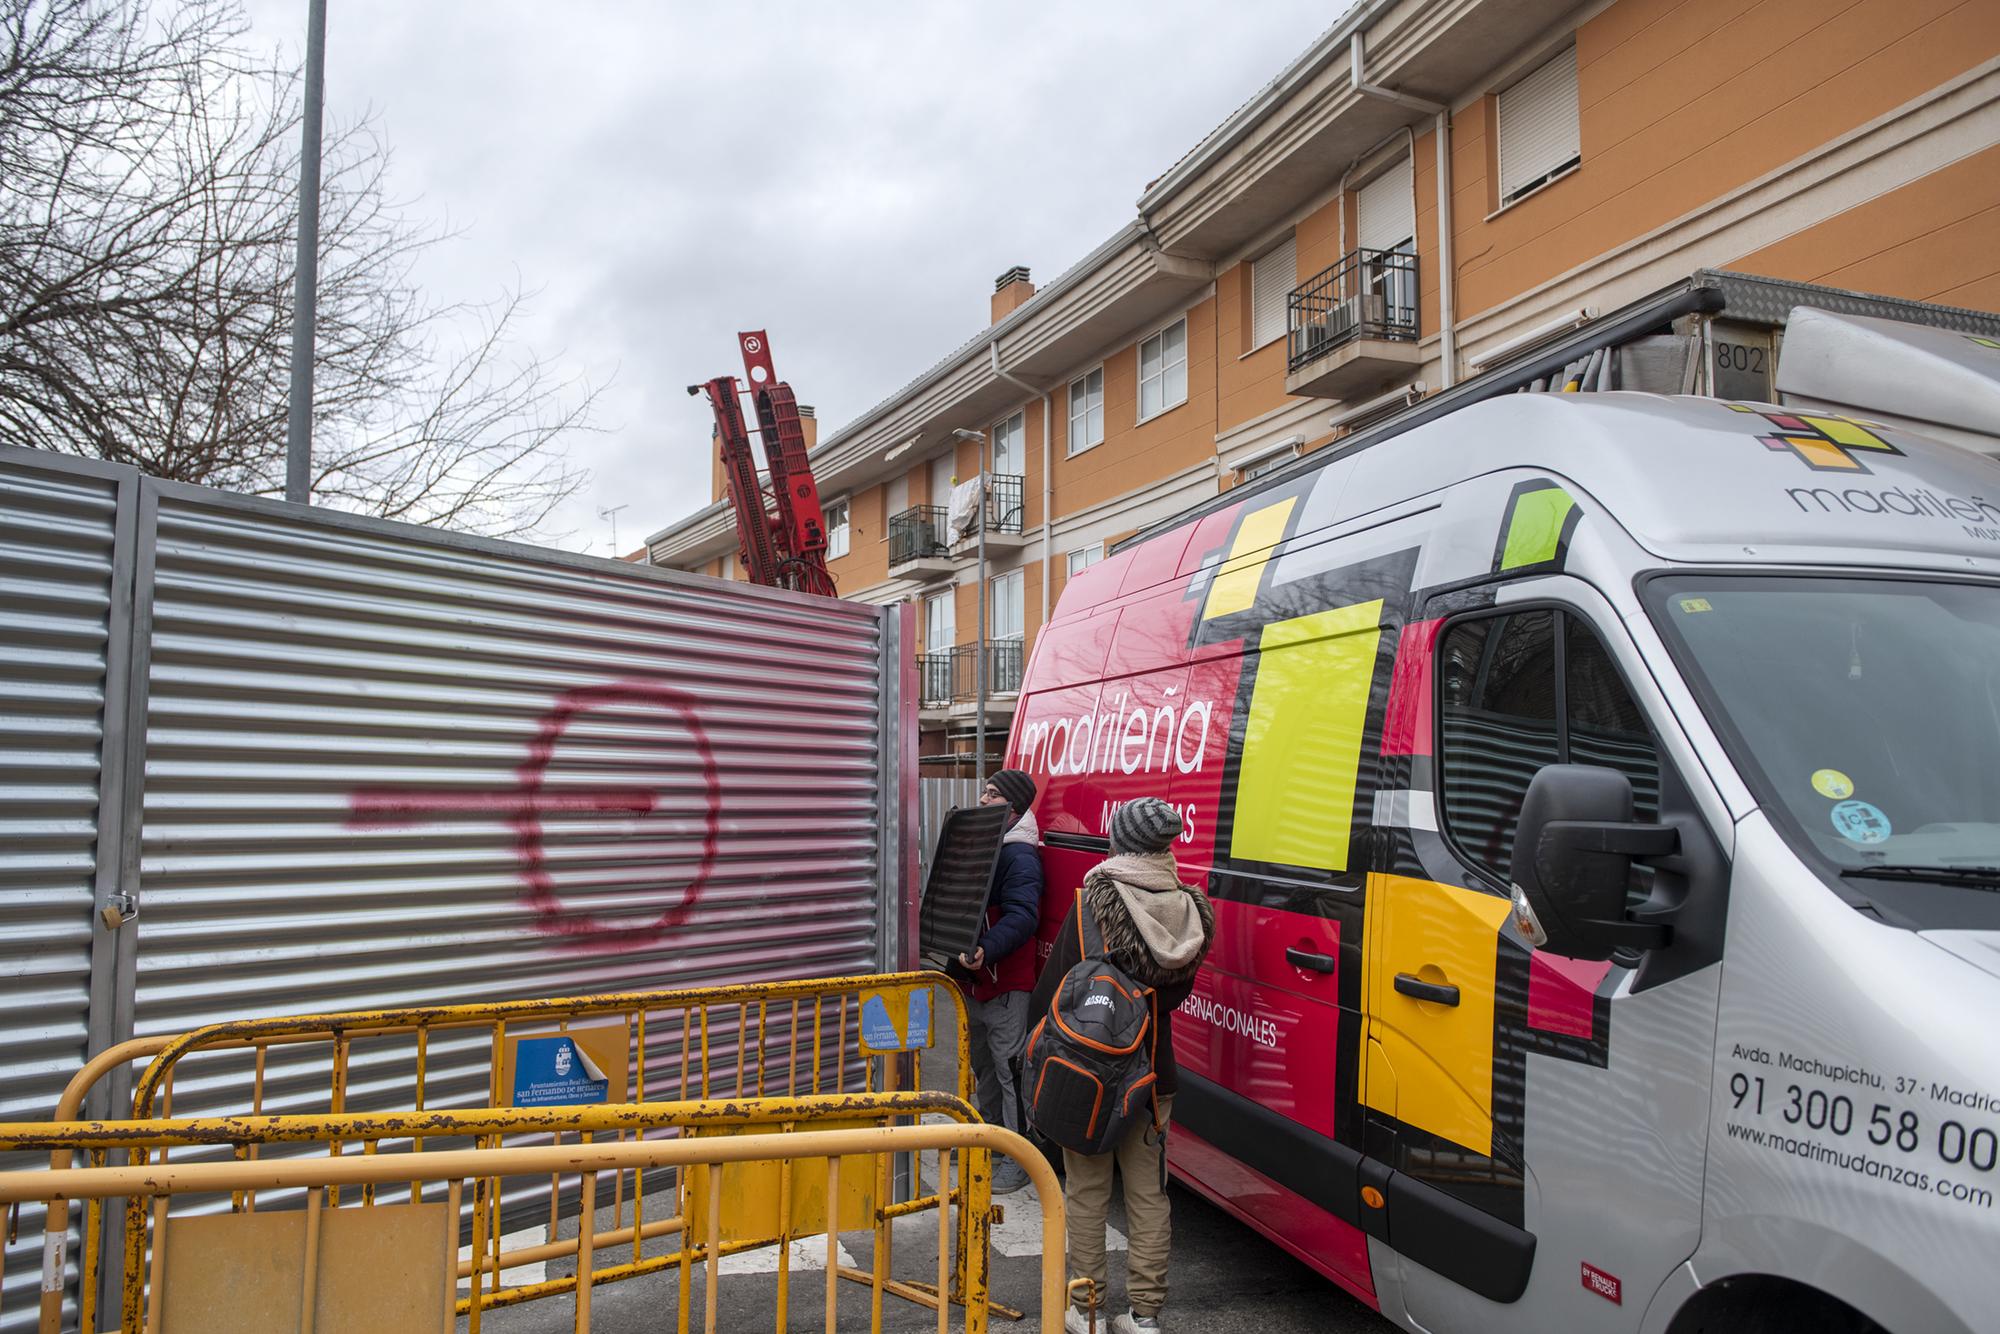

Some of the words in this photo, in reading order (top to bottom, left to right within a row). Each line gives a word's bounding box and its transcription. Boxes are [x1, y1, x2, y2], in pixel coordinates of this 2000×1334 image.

[1718, 343, 1764, 374] 802
[1020, 684, 1213, 775] madrileña
[1178, 994, 1276, 1048] ERNACIONALES
[1732, 1044, 1773, 1066] Avda.
[1779, 1051, 1885, 1091] Machupichu,
[1895, 1076, 1917, 1095] 37
[1730, 1072, 1765, 1115] 91
[1783, 1084, 1853, 1136] 300
[1867, 1103, 1919, 1152] 58
[1938, 1120, 1998, 1173] 00
[1727, 1122, 1993, 1208] www.madrimudanzas.com
